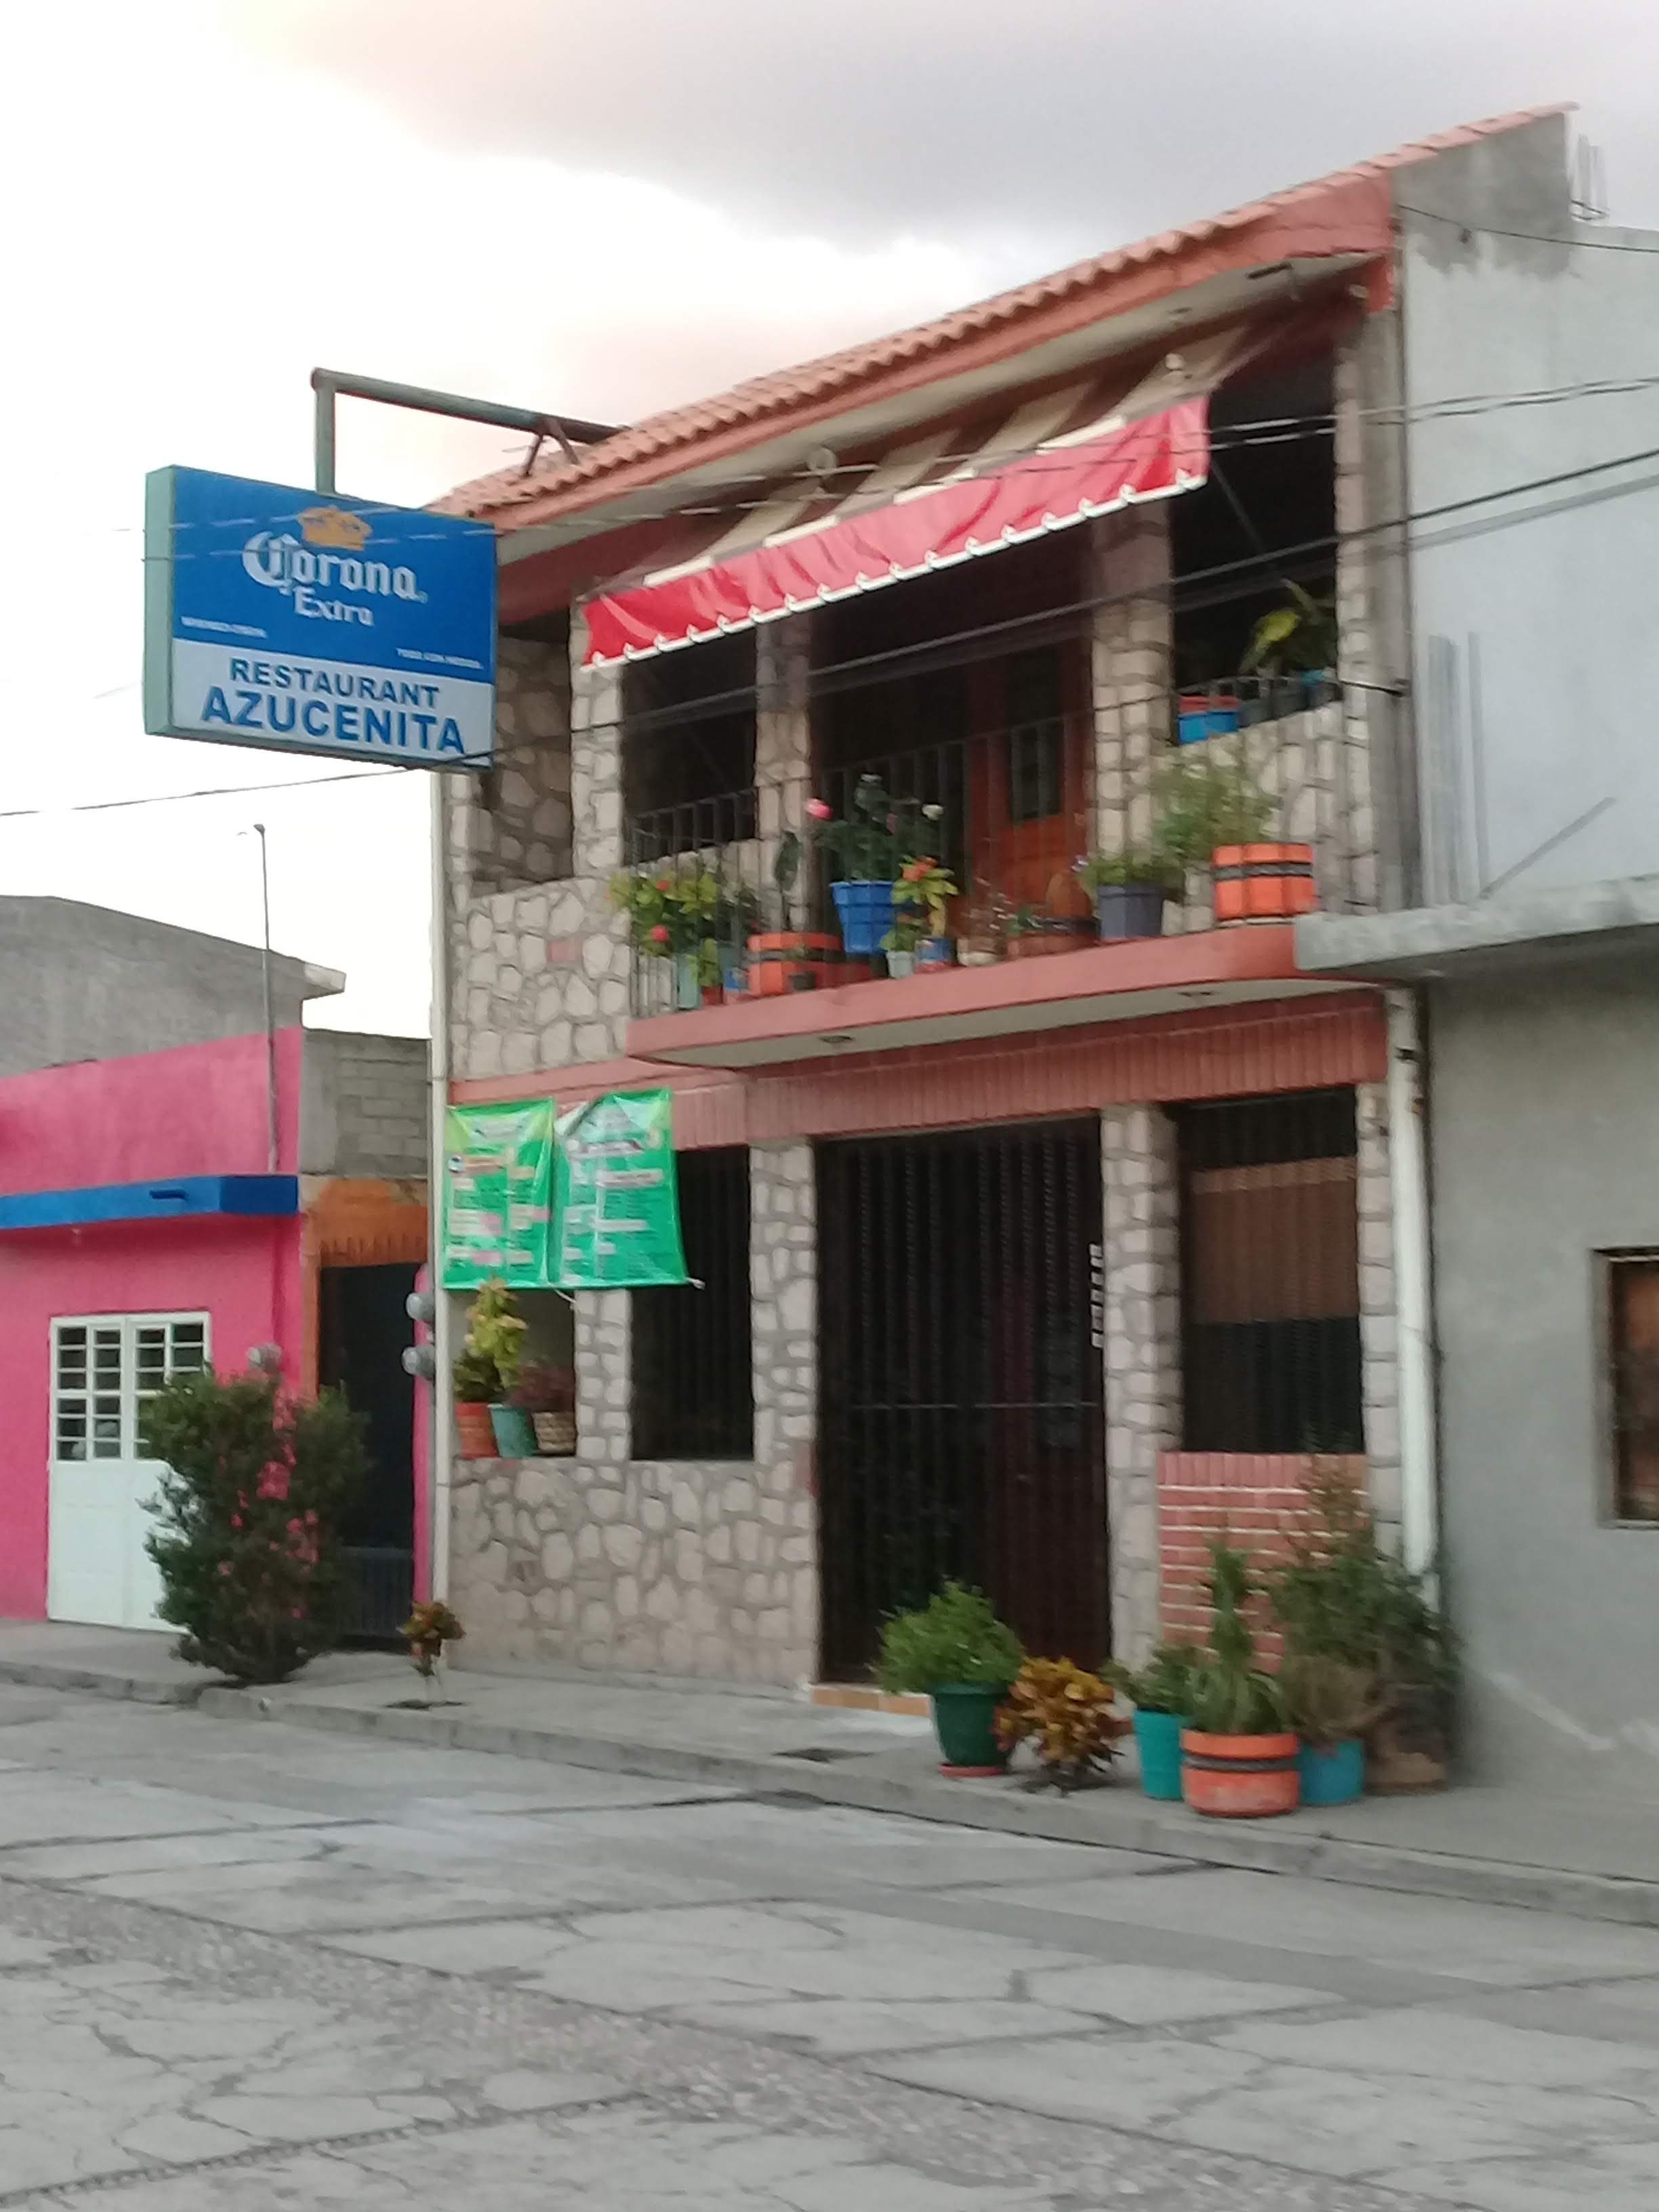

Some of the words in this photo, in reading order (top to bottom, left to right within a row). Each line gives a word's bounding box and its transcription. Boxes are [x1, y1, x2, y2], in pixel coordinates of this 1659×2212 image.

[242, 531, 420, 602] Corona
[294, 586, 374, 626] Extra
[230, 657, 440, 709] RESTAURANT
[201, 686, 465, 754] AZUCENITA
